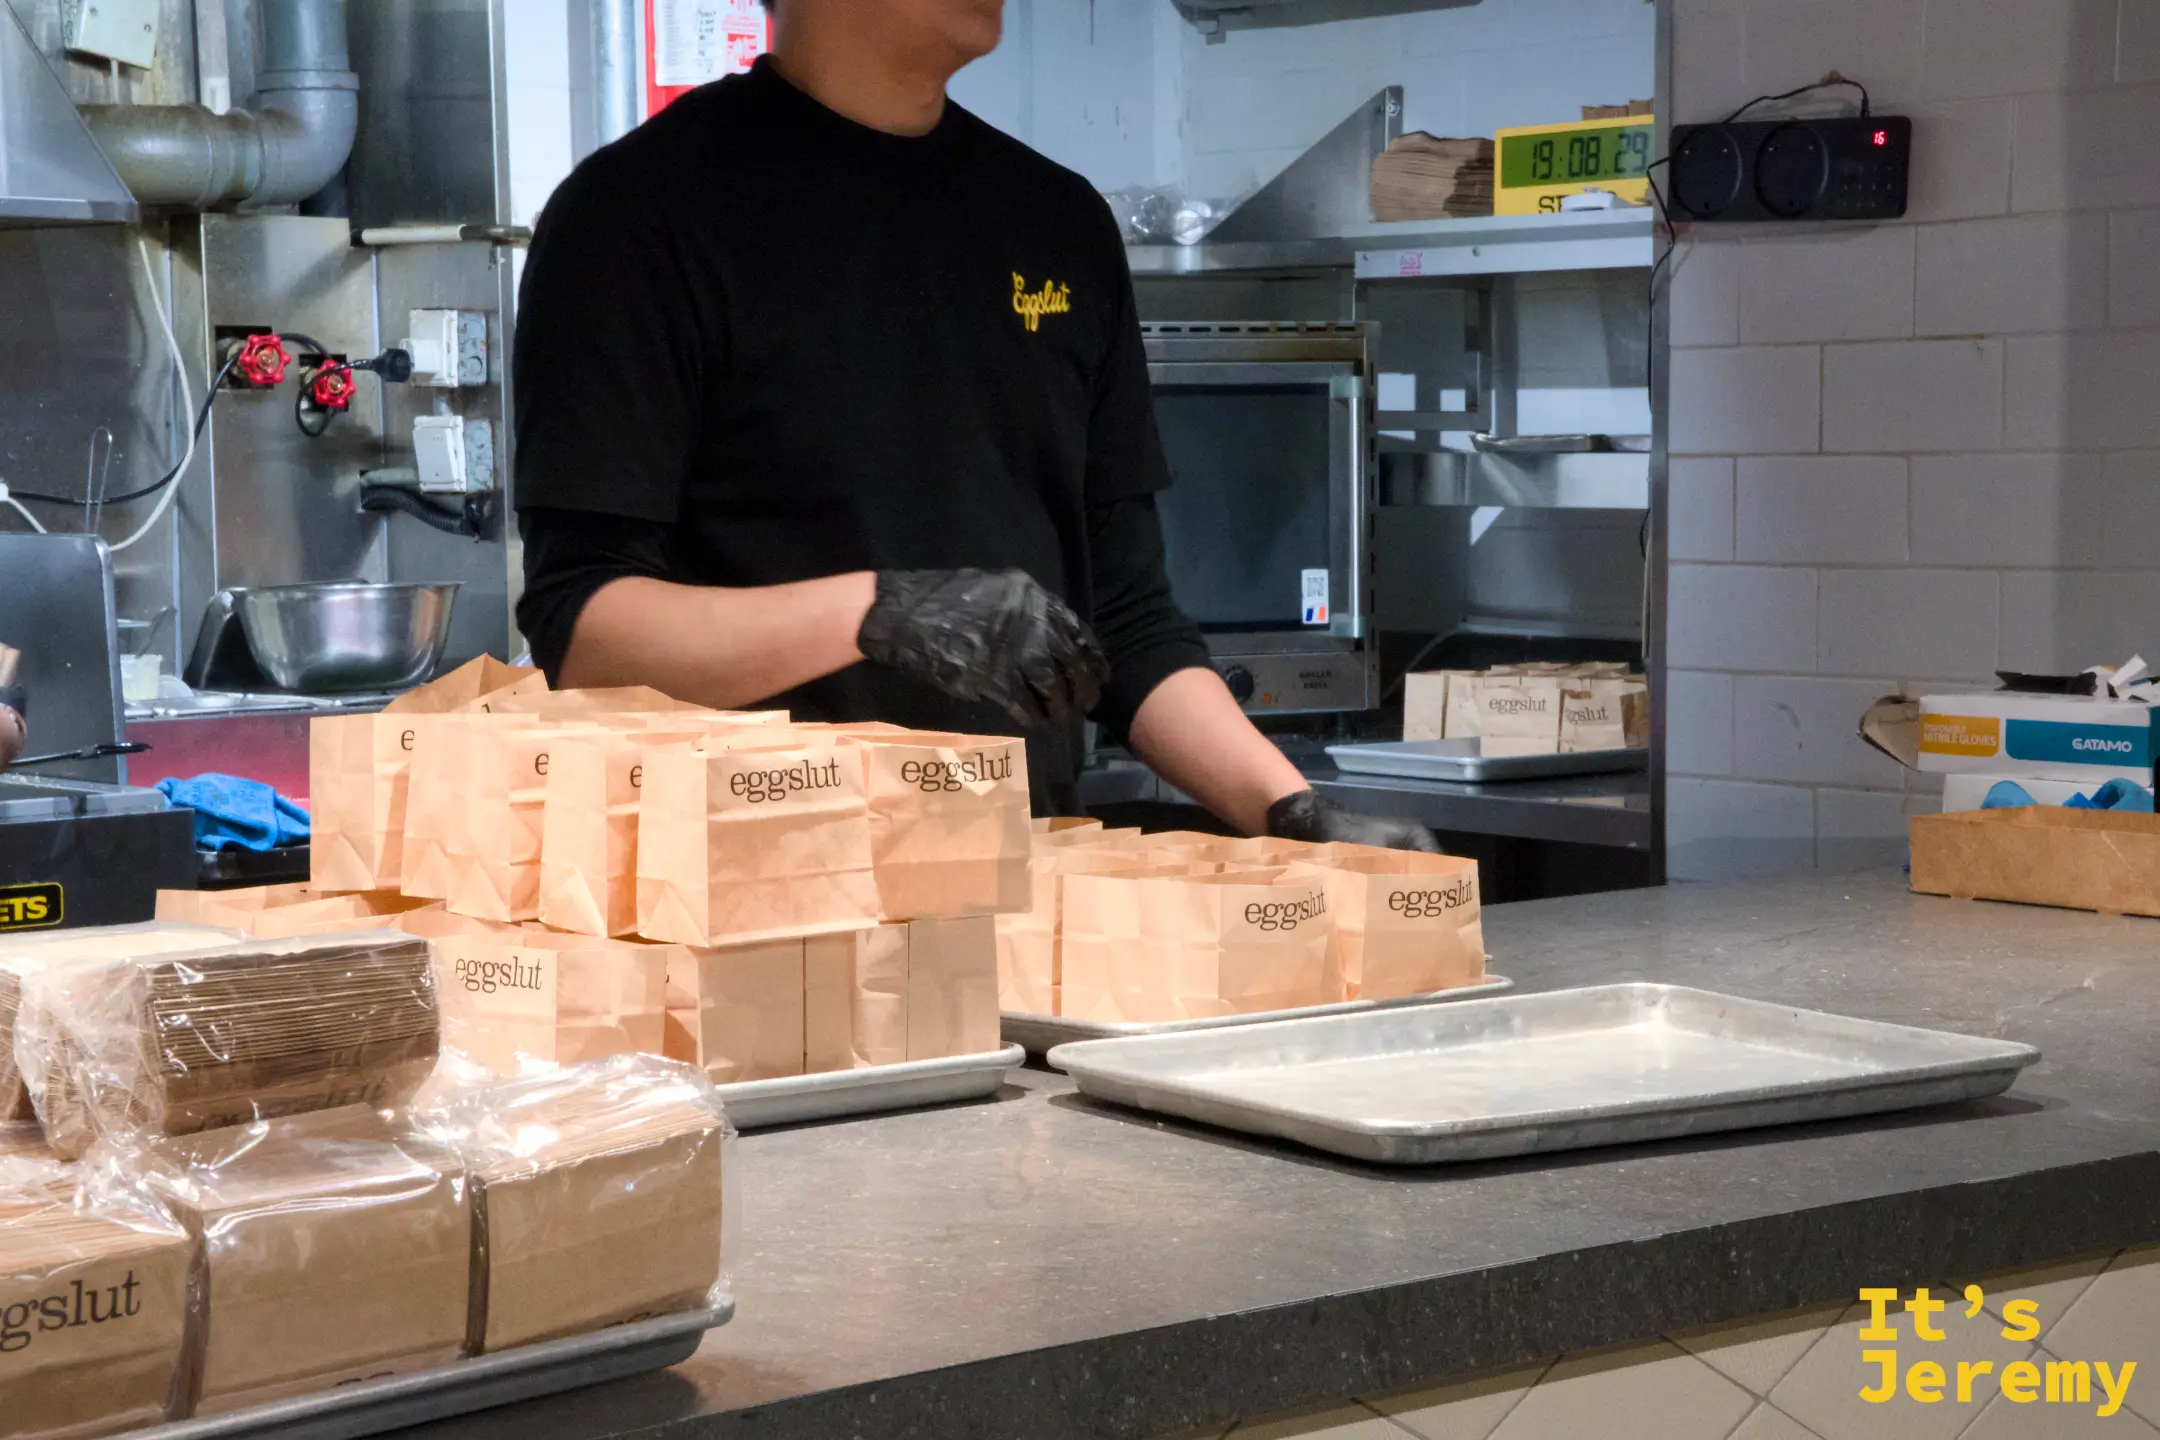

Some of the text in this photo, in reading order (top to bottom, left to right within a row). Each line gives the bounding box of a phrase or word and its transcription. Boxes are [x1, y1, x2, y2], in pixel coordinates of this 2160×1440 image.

[1874, 131, 1885, 145] 16
[1489, 696, 1547, 715] eggslut
[1566, 706, 1609, 725] gslut
[1959, 733, 1996, 746] GLOVES
[2072, 738, 2133, 753] GATAMO
[730, 757, 841, 803] eggslut
[901, 748, 1013, 792] eggslut
[1244, 885, 1326, 931] eggslut
[1388, 873, 1472, 918] eggslut
[455, 956, 542, 993] eggslut
[0, 1269, 140, 1352] gslut
